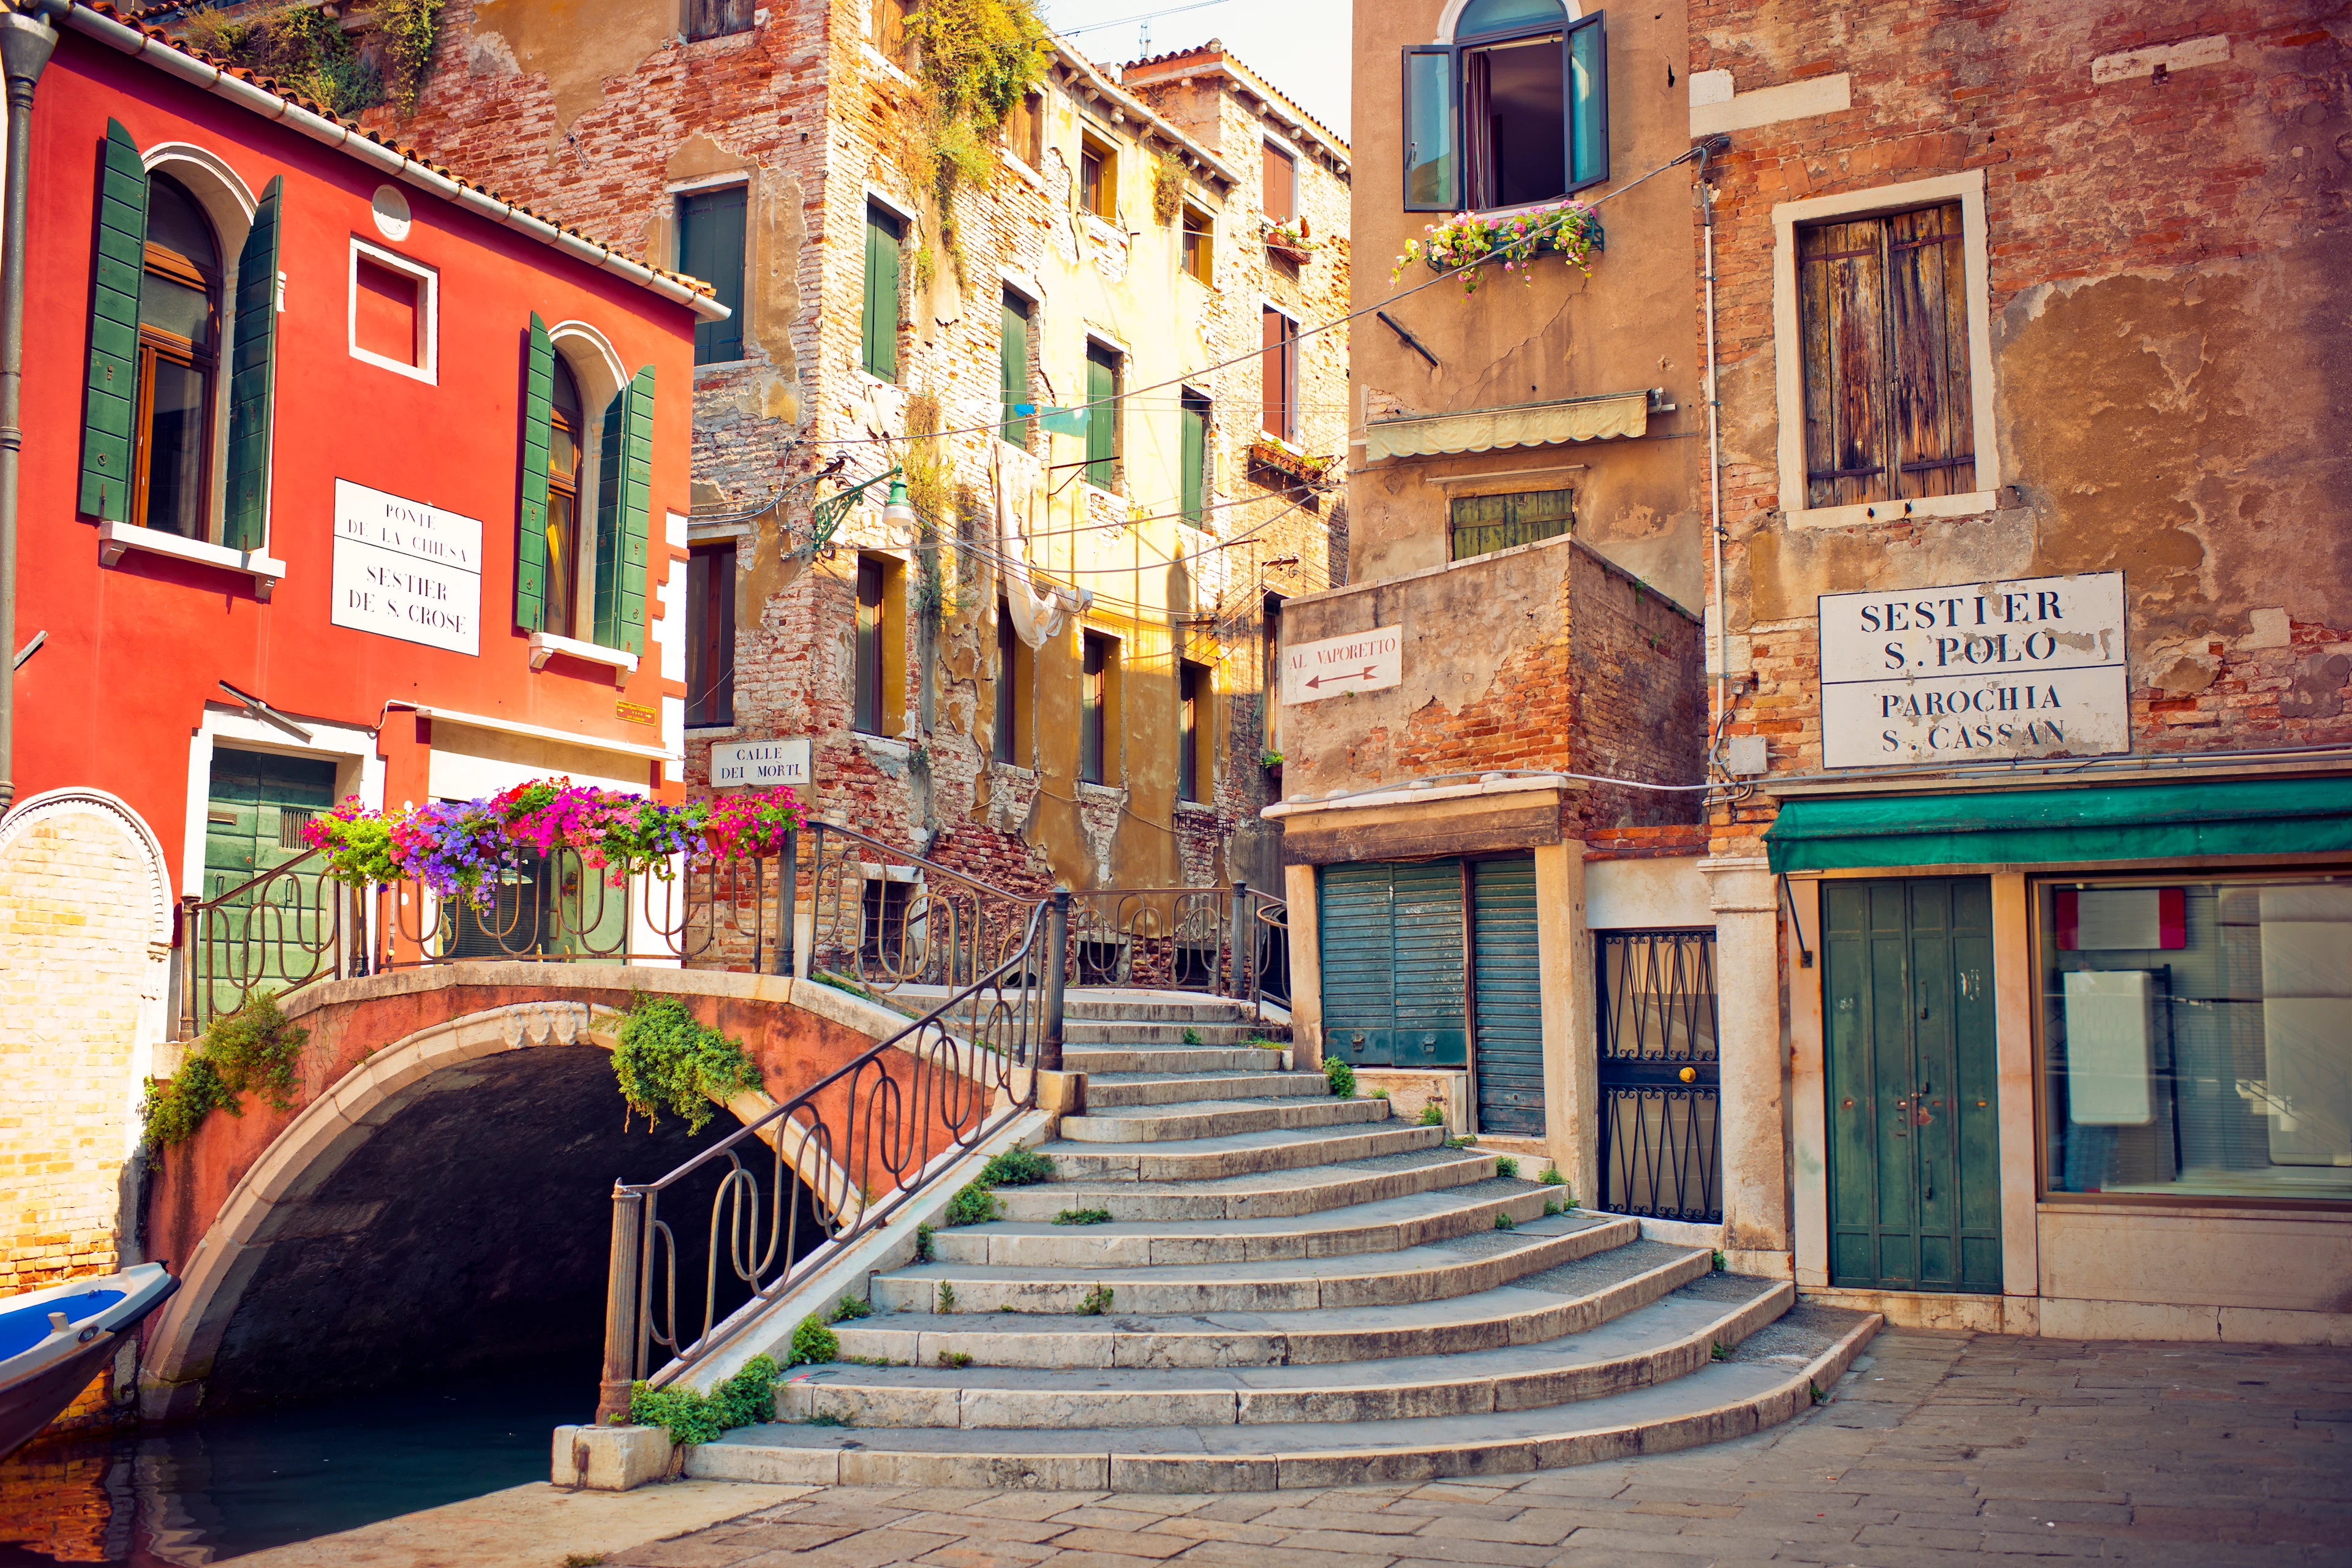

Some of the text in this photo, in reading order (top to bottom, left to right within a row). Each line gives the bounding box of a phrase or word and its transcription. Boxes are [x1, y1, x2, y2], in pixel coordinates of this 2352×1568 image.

[349, 519, 466, 562] DE LA CHIESA
[367, 565, 447, 601] SESTIER
[349, 589, 466, 635] DE S. CROSE
[1860, 590, 2064, 633] SESTIER
[1289, 638, 1396, 670] AL VAPORETTO
[1937, 631, 2056, 667] POLO
[1881, 684, 2062, 718] PAROCHIA
[722, 764, 799, 779] DEI MORTI
[736, 747, 782, 761] CALLE
